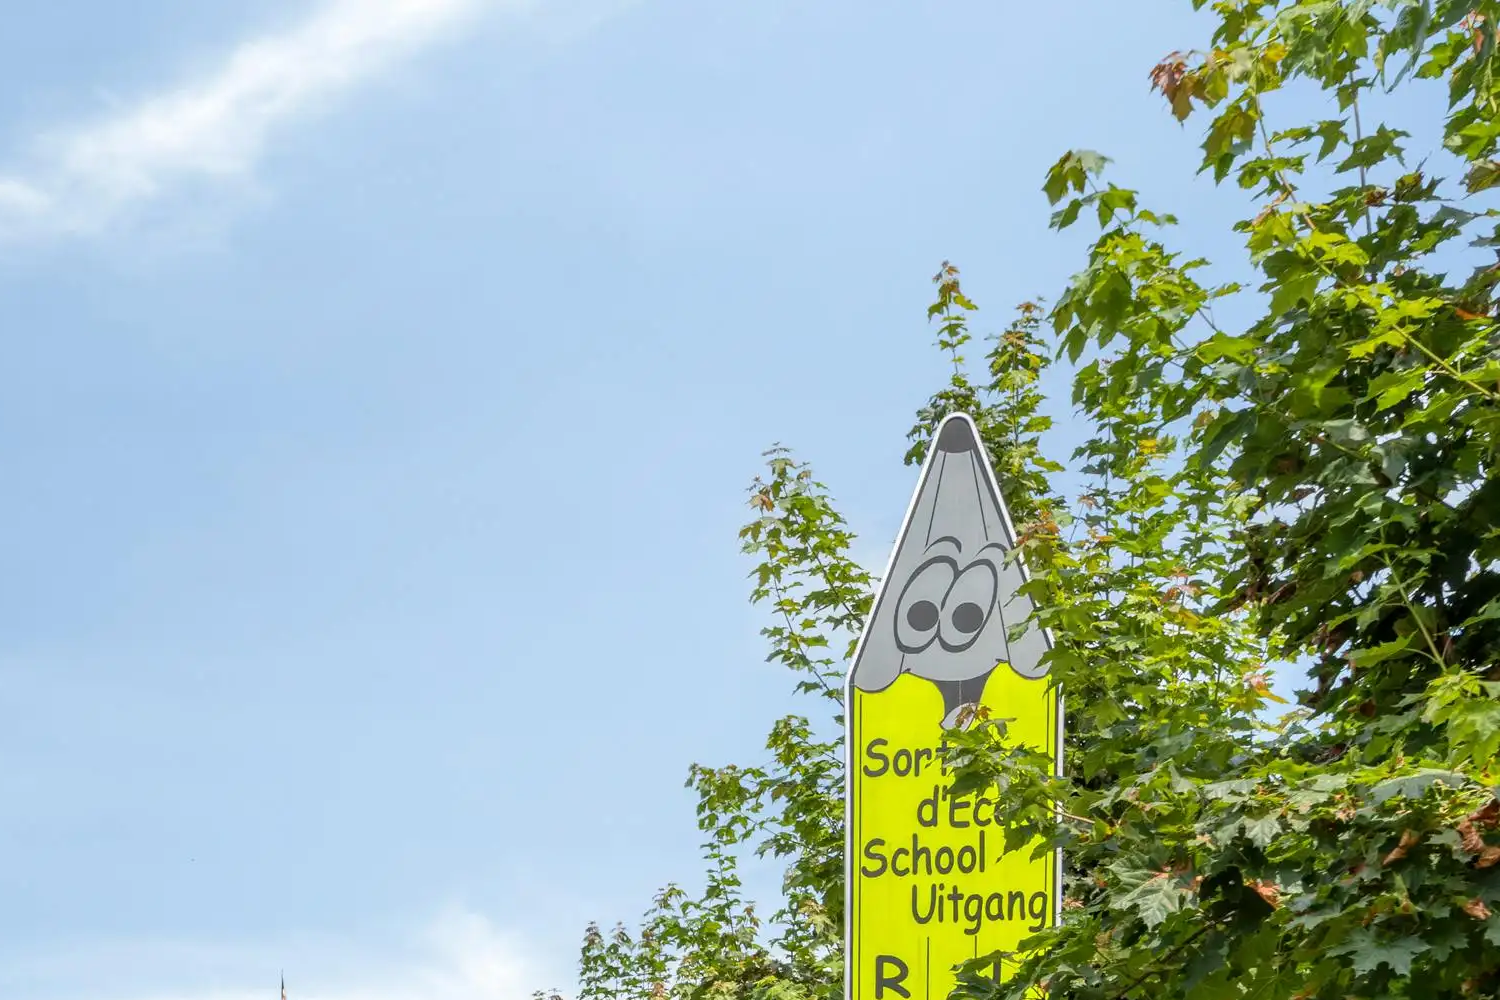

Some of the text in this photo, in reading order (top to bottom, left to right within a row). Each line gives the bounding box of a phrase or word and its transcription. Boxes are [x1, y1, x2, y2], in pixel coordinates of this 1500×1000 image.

[863, 738, 954, 777] Sort
[917, 784, 1007, 828] d'Ec
[861, 830, 986, 878] School
[911, 883, 1048, 936] Uitgang
